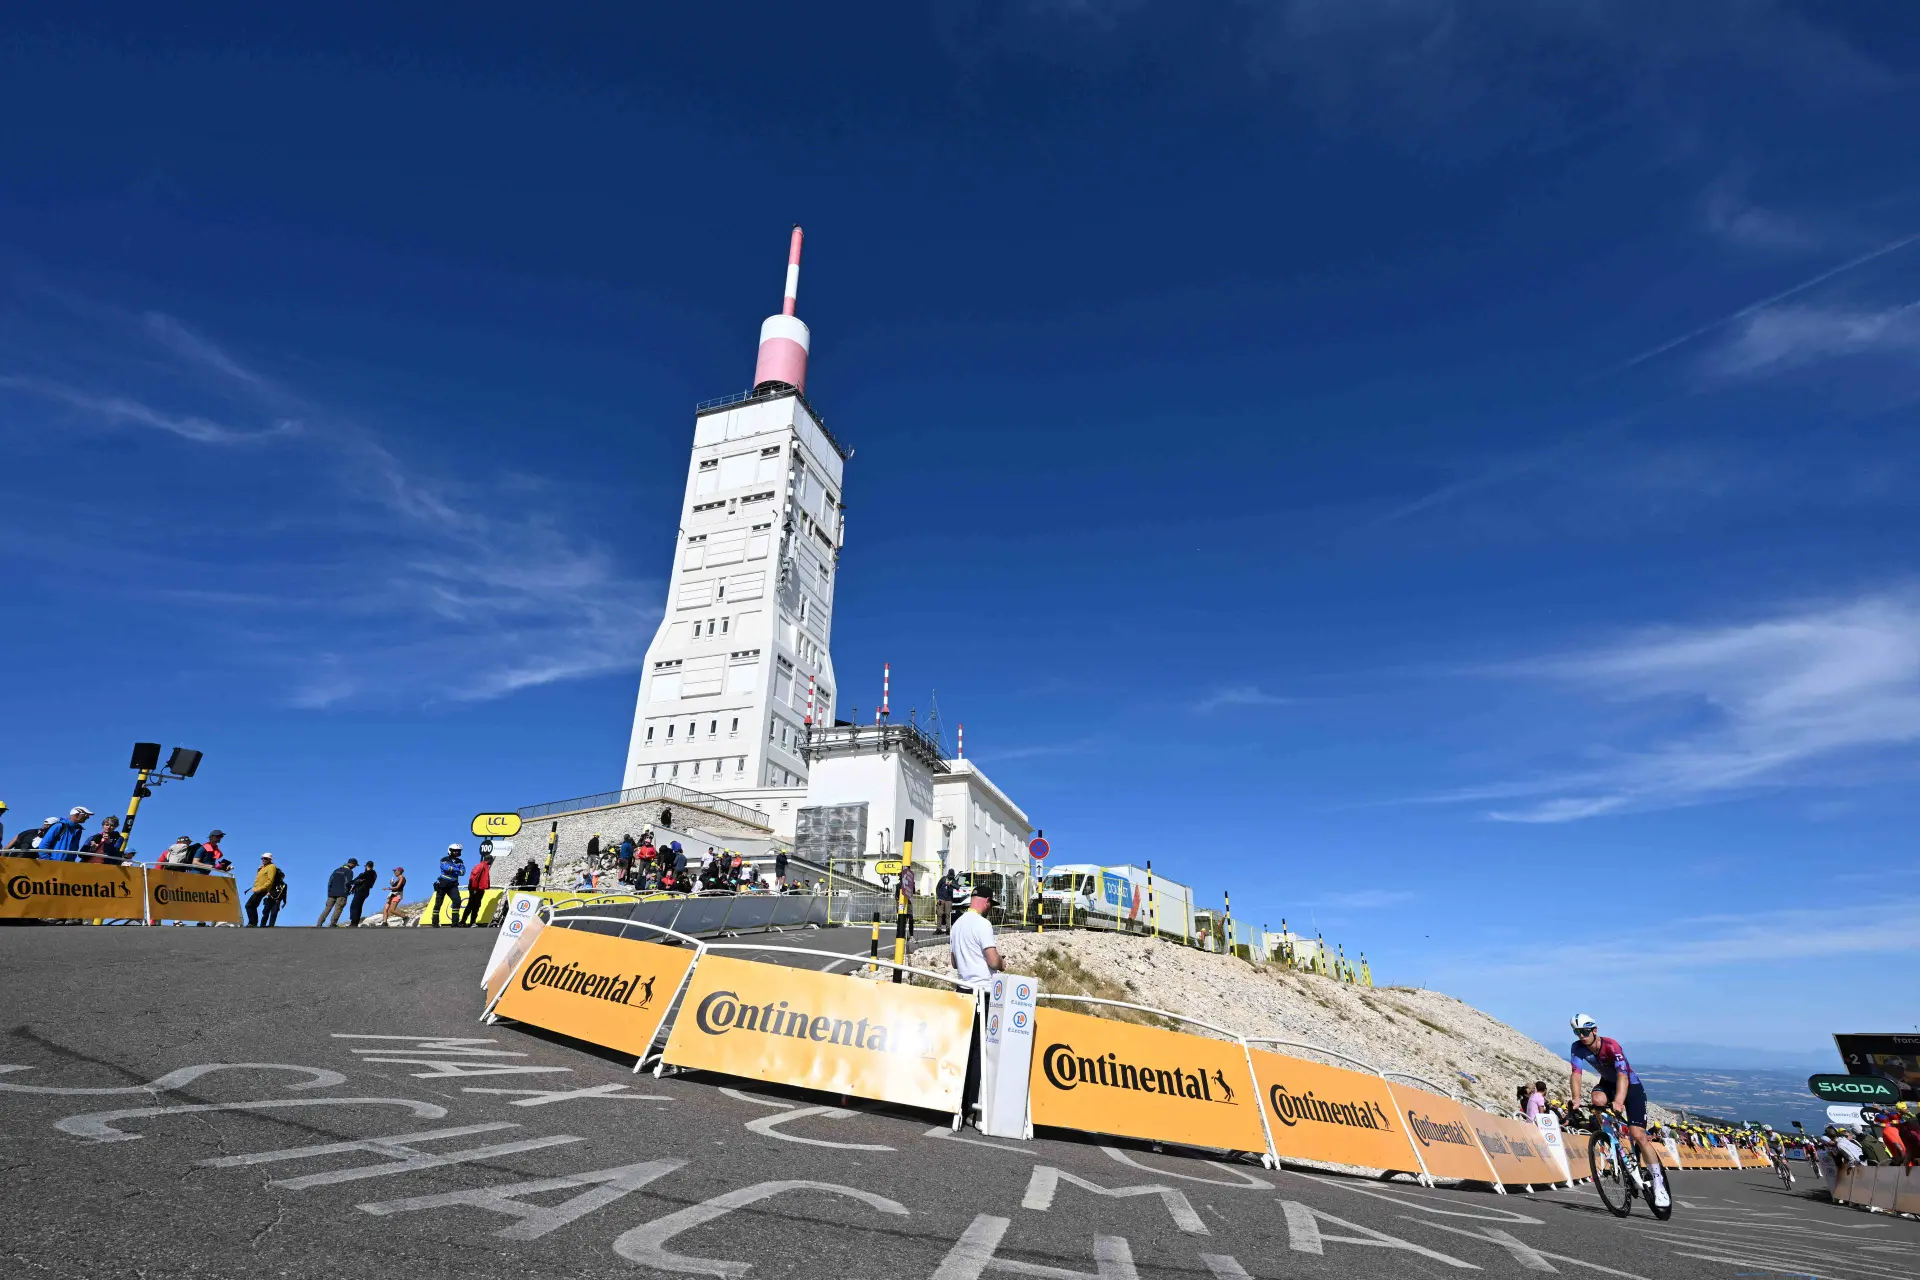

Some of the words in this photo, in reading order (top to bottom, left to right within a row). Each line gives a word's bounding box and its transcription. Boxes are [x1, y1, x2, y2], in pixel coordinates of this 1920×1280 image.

[488, 817, 508, 826] LCL
[481, 844, 492, 853] 100
[7, 875, 116, 899] Continental
[154, 883, 221, 905] Continental
[521, 954, 642, 1005] Continental
[696, 990, 903, 1053] Continenta
[1043, 1043, 1213, 1101] Continental
[1849, 1053, 1861, 1065] 2
[1270, 1084, 1380, 1131] Continental
[1408, 1110, 1469, 1147] Continental
